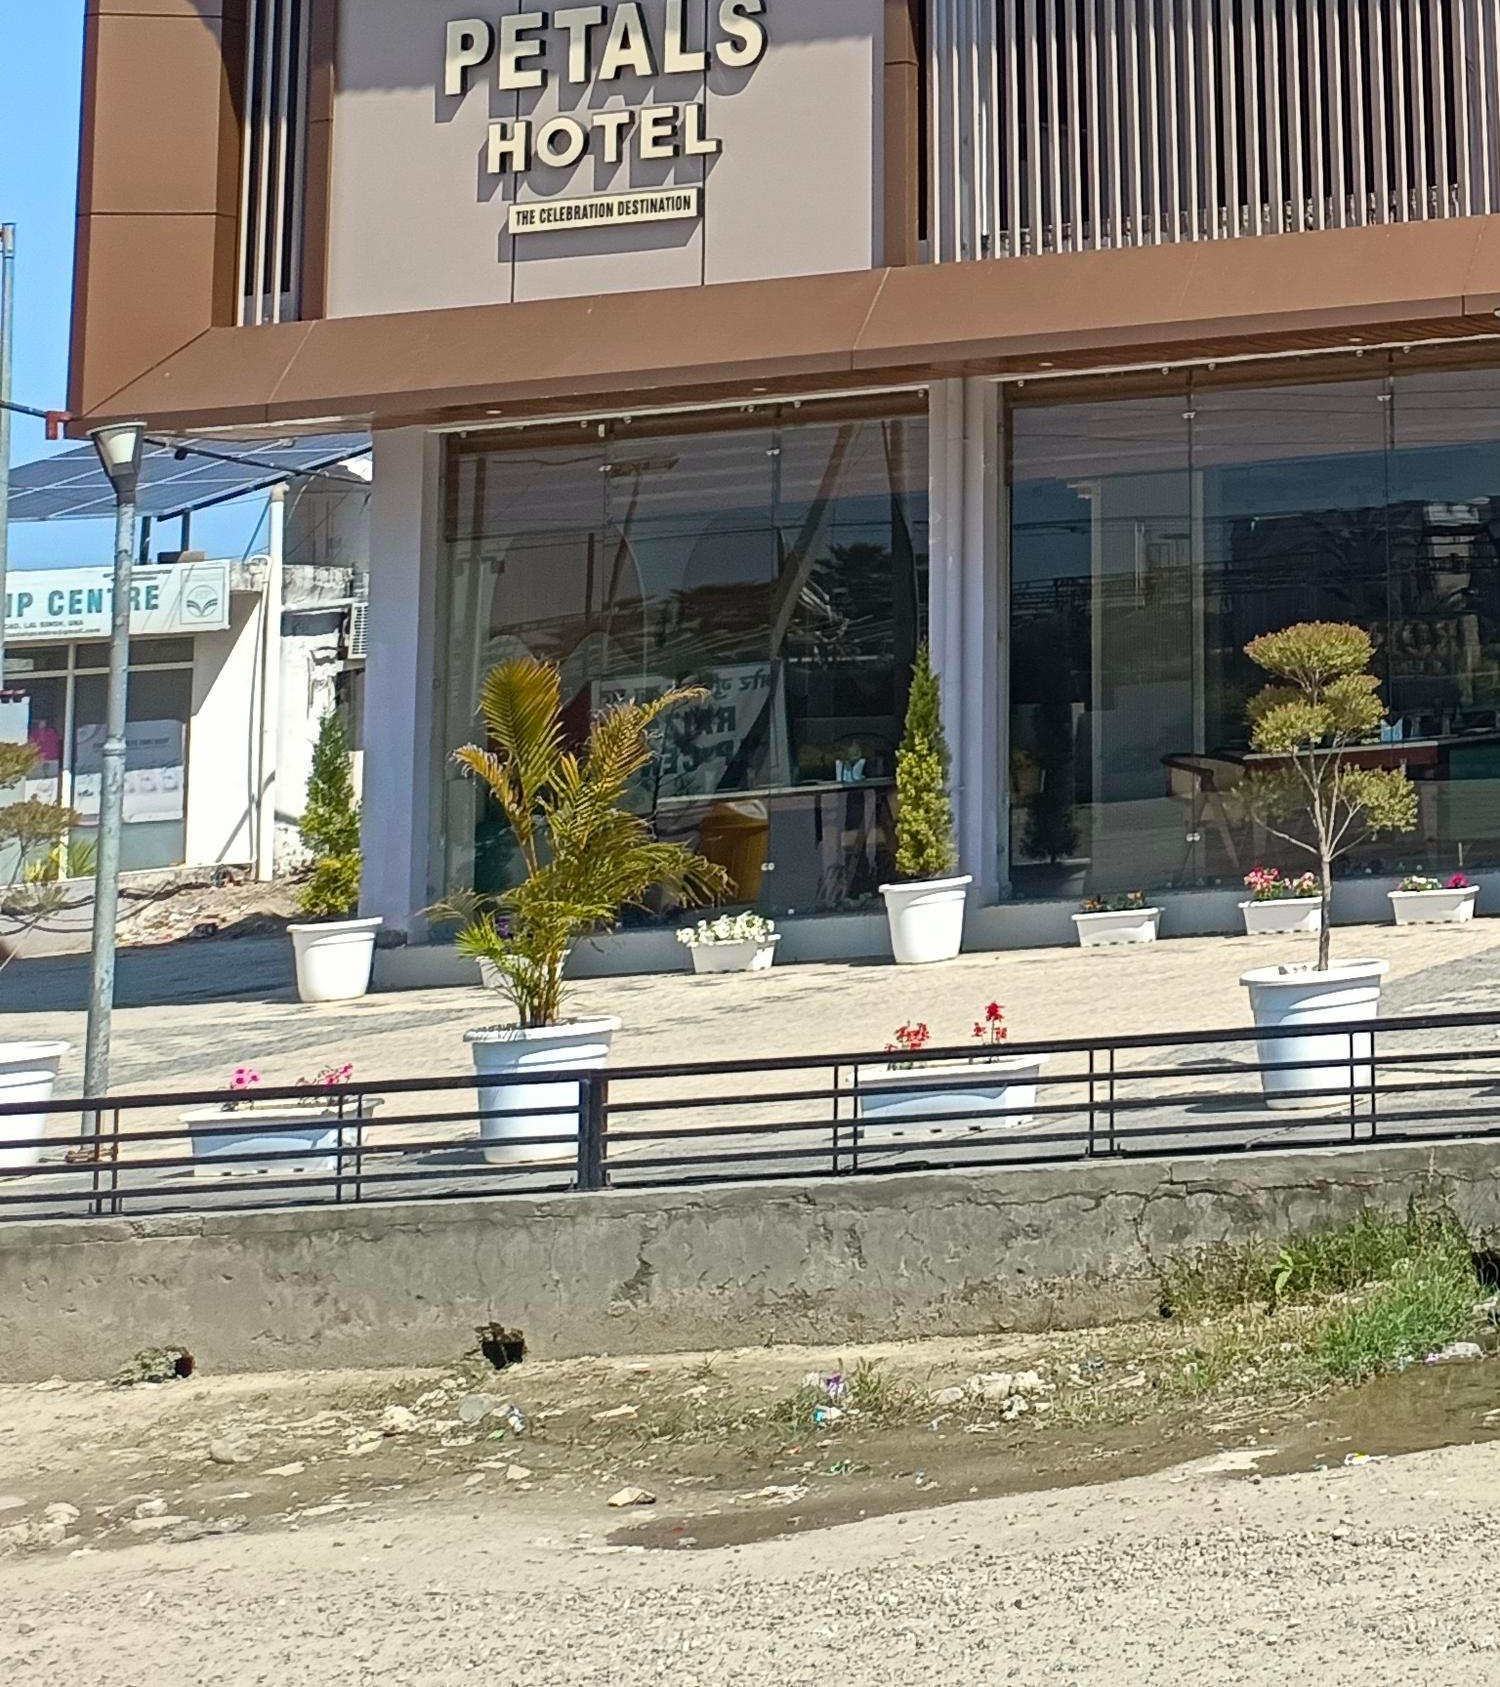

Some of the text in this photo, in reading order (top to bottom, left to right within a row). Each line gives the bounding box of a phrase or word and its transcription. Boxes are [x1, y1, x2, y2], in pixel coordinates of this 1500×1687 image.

[486, 103, 721, 174] HOTEL
[516, 195, 692, 226] THE CELEBRATION DESTINATION
[47, 584, 160, 617] CENRE
